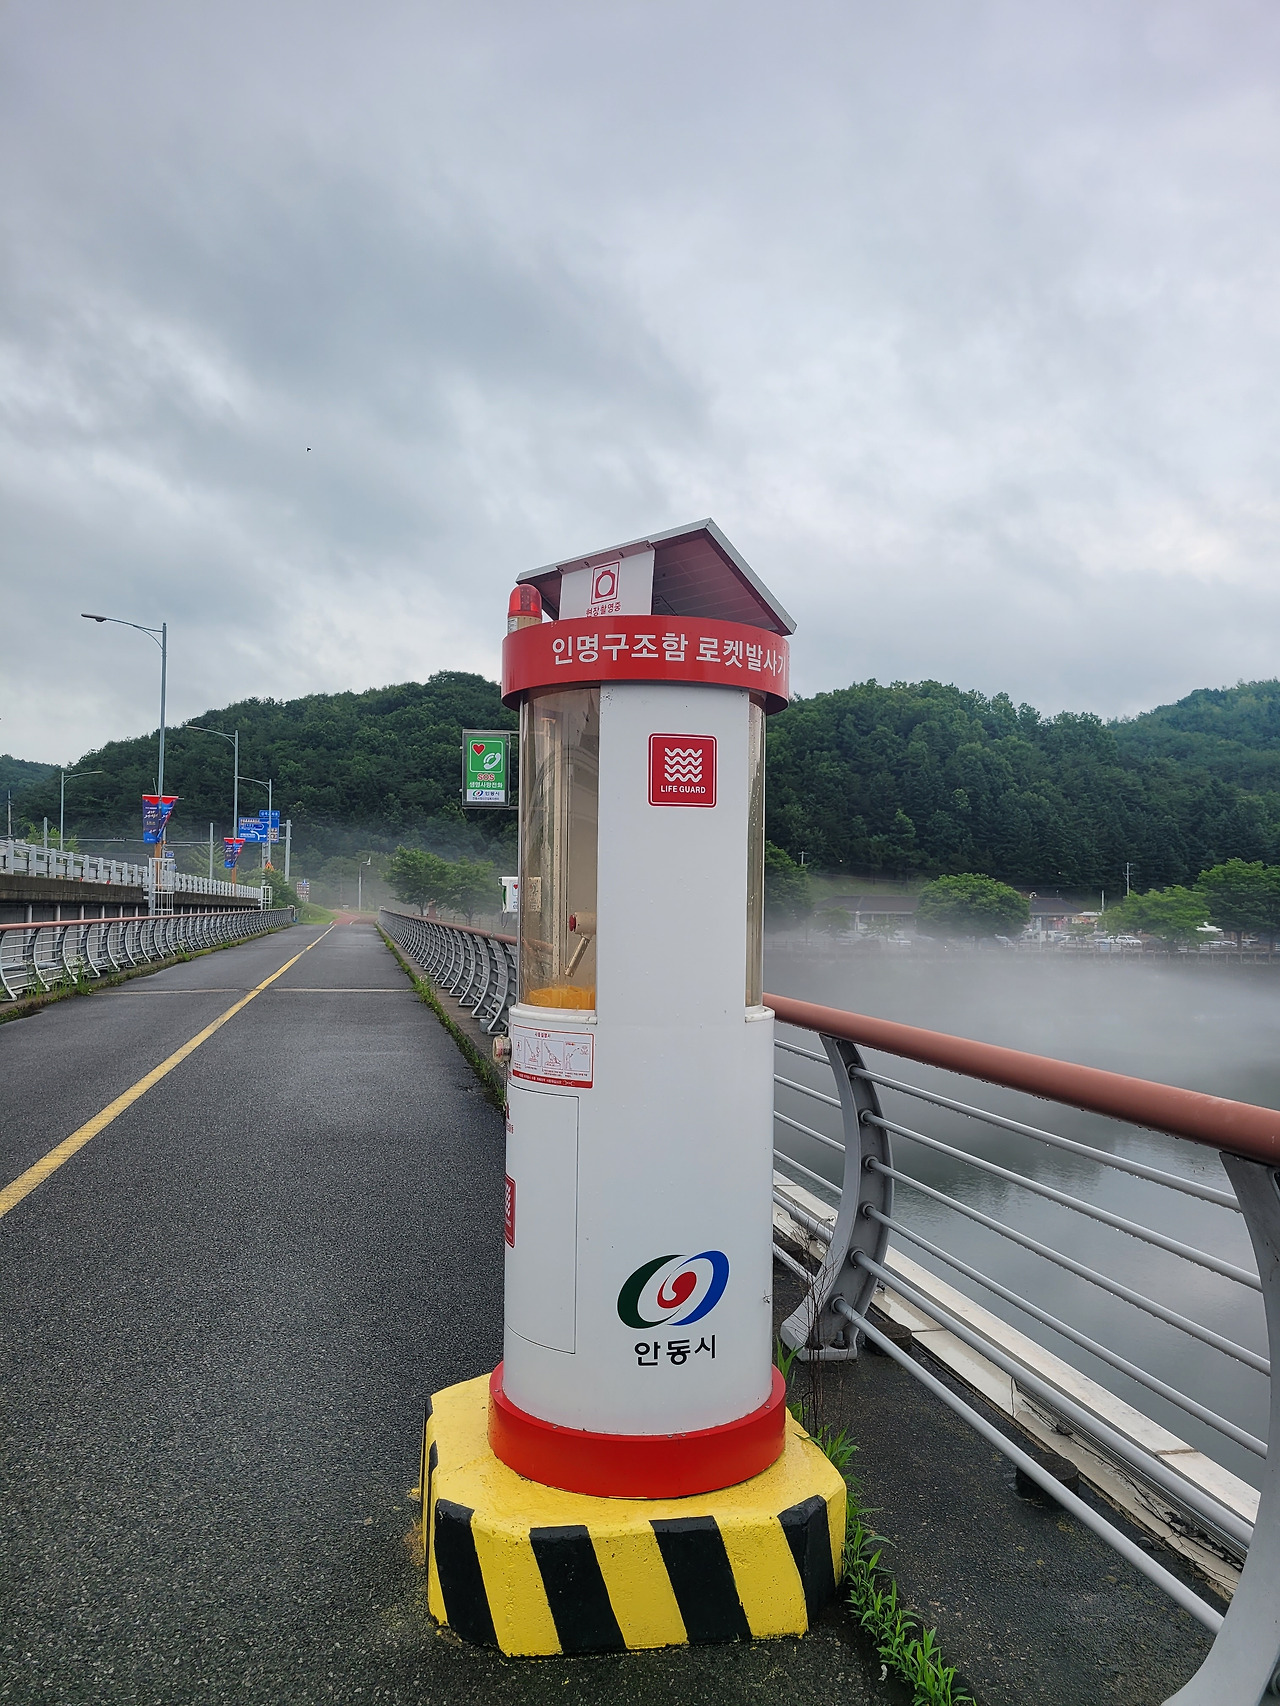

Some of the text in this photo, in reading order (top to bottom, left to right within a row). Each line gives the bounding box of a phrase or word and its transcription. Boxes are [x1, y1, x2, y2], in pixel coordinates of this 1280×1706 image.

[586, 602, 621, 617] 현장촬영중
[552, 632, 786, 681] 인명구조함 로켓발사기
[477, 773, 495, 781] SOS
[660, 785, 706, 794] LIFE GUARD
[634, 1334, 716, 1366] 안동시
